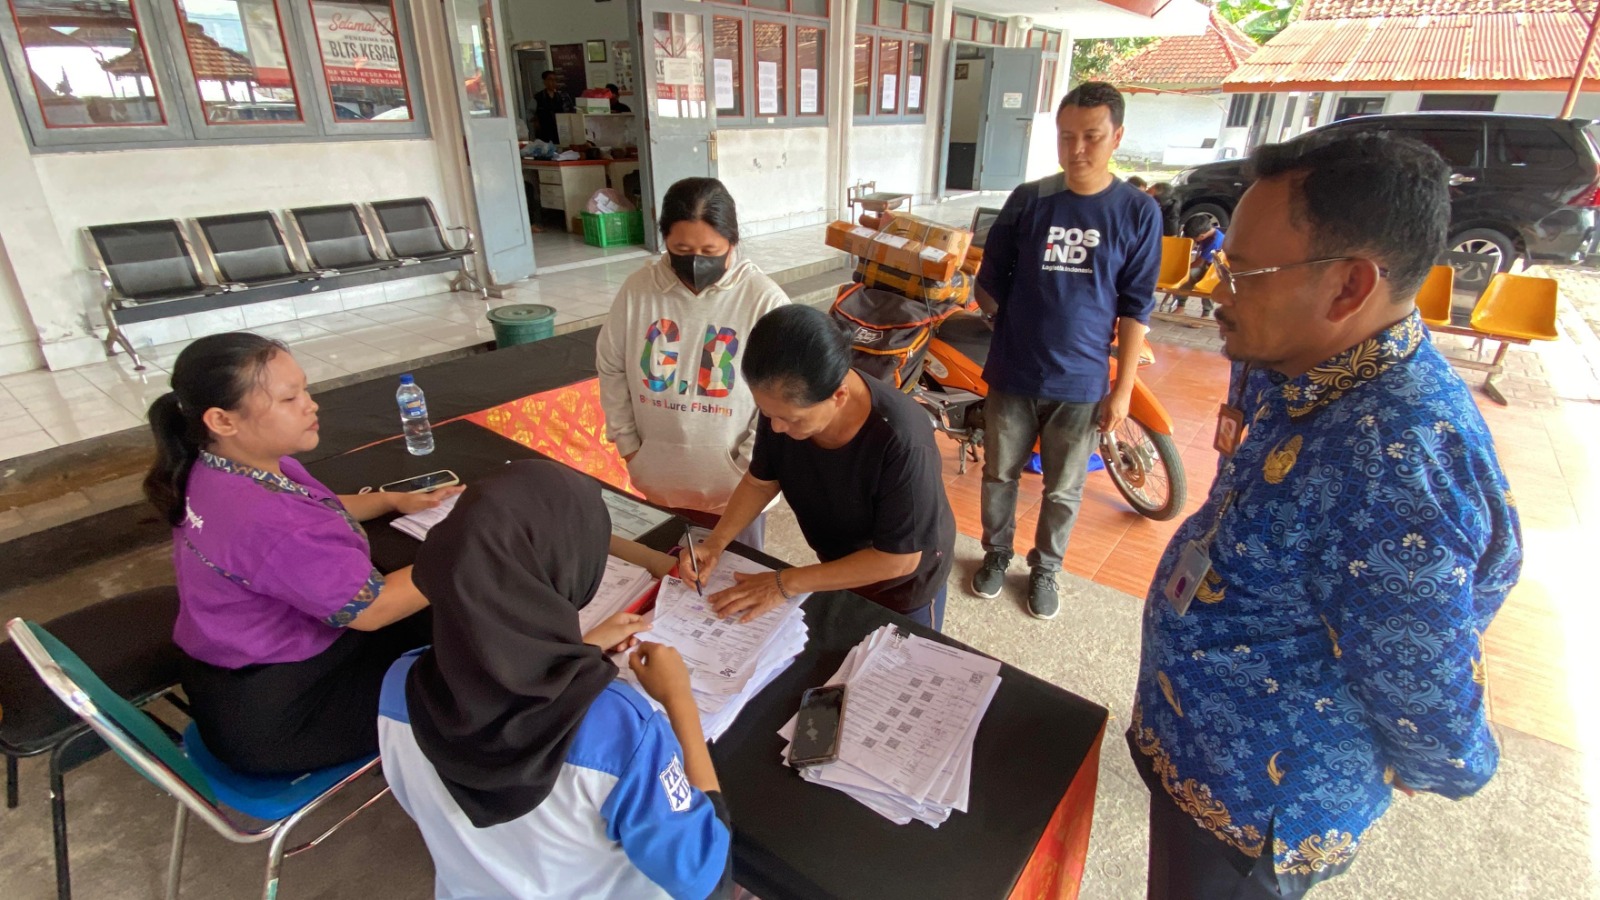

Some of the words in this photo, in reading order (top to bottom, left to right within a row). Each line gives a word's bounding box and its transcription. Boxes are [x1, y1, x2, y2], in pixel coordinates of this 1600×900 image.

[329, 40, 359, 59] BLTS
[360, 43, 397, 61] KESRA
[1047, 226, 1100, 247] POS
[664, 399, 687, 412] Lure
[691, 402, 733, 417] Fishing
